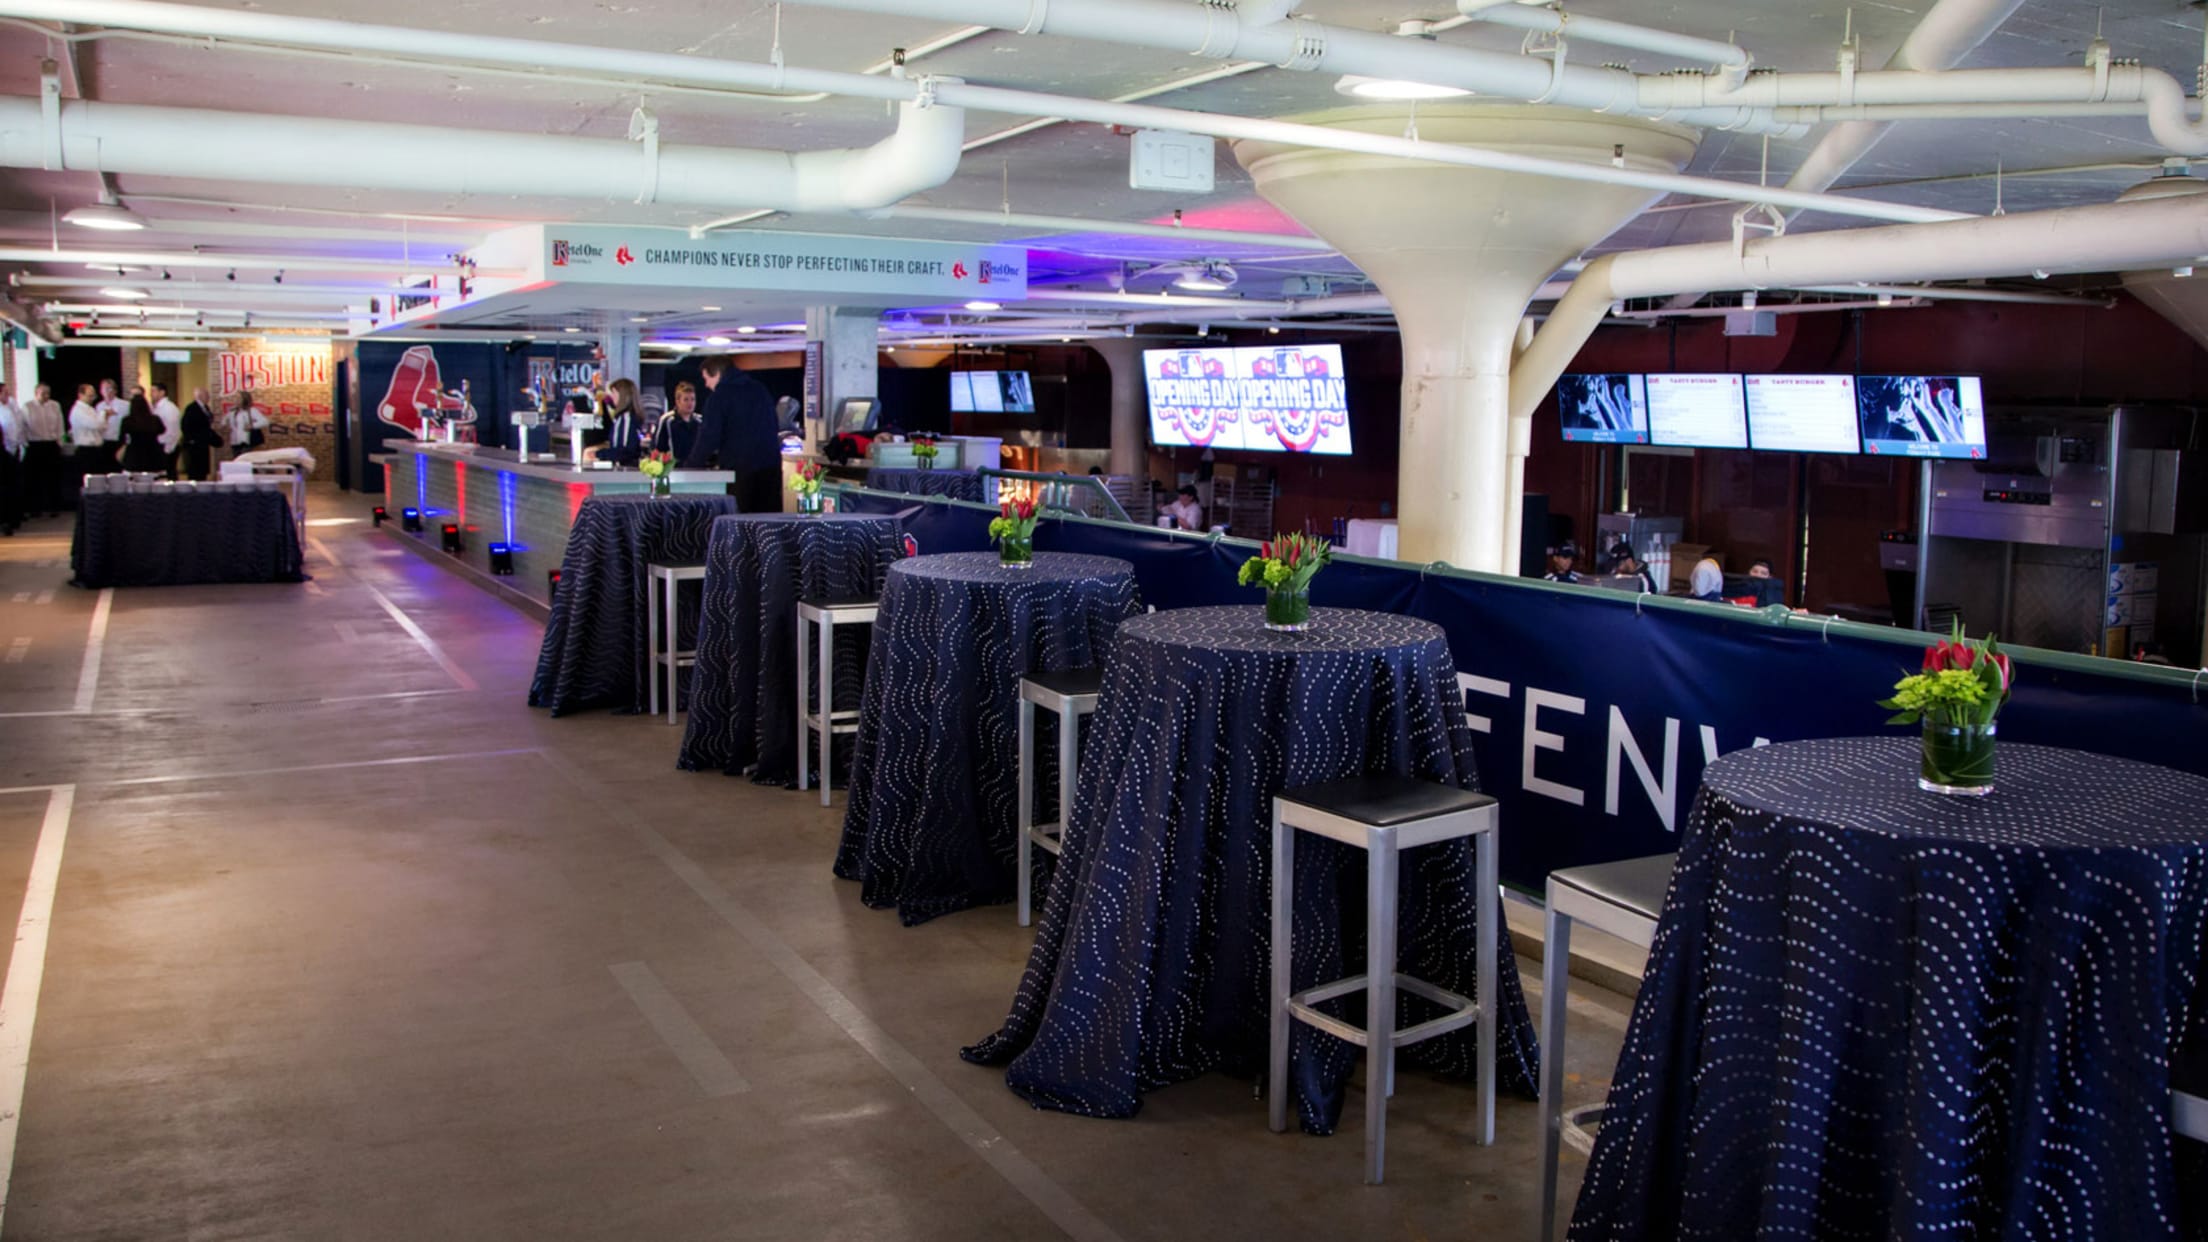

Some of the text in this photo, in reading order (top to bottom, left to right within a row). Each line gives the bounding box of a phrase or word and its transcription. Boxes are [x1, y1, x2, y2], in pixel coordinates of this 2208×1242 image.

[584, 244, 603, 257] One
[646, 248, 945, 276] CHAMPIONS NEVER STOP PERFECTING THEIR CRAFT.
[220, 352, 328, 398] BOSTON
[1151, 378, 1239, 409] OPENING DAY
[1241, 378, 1346, 410] OPENING DAY
